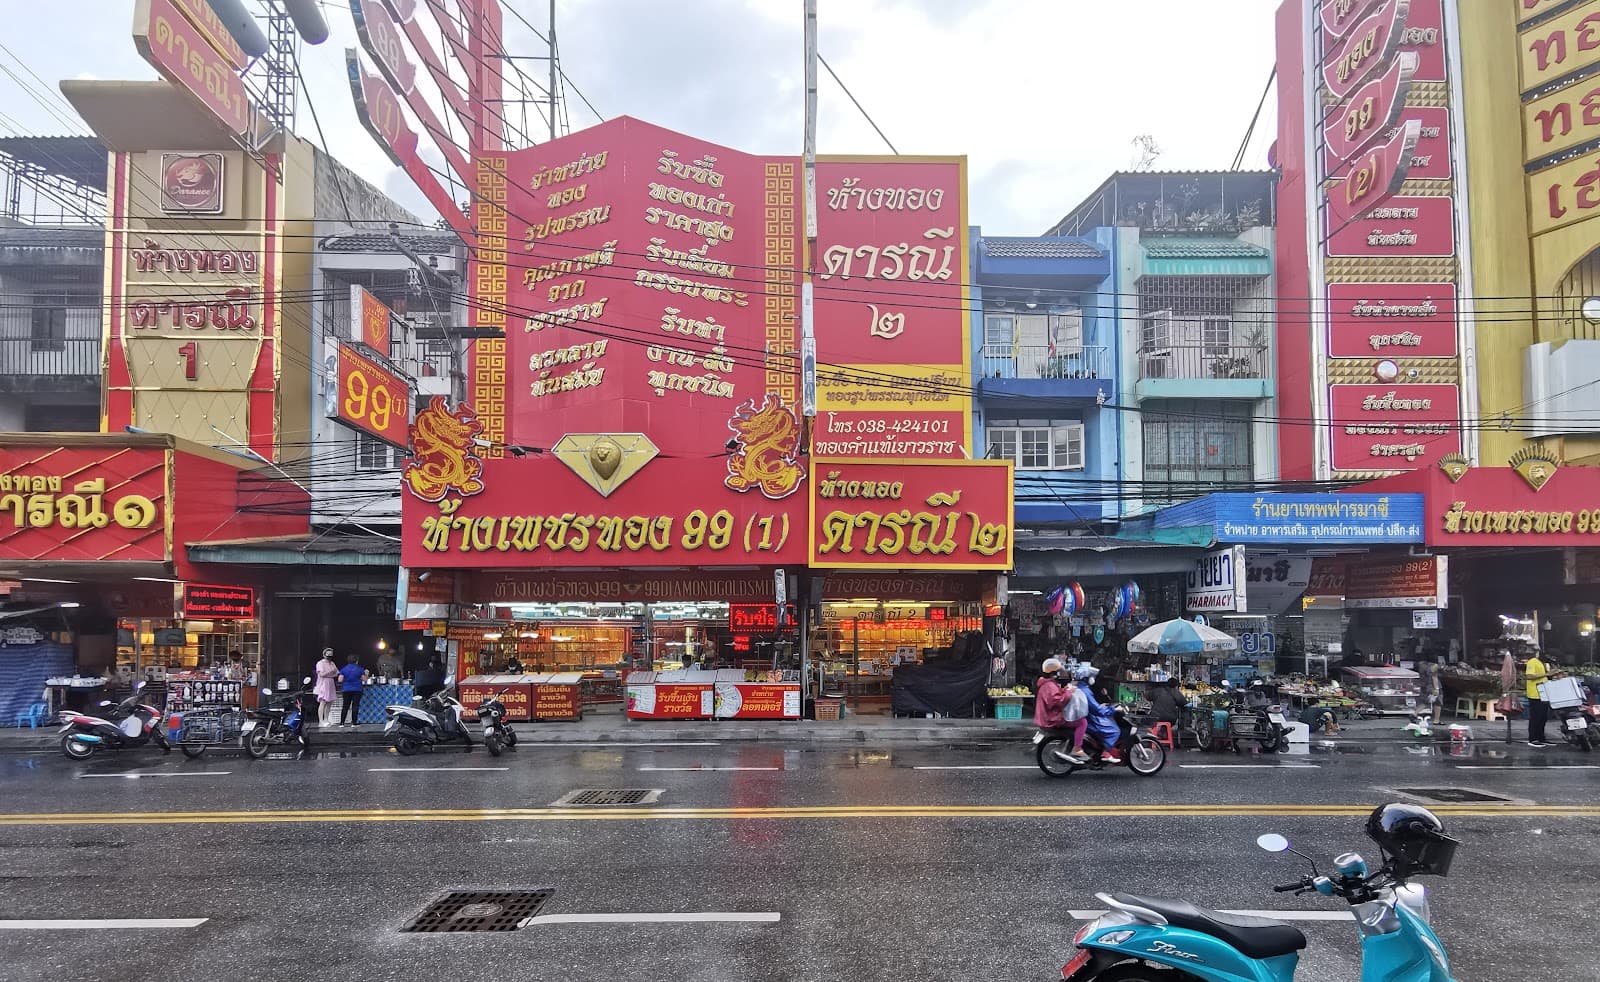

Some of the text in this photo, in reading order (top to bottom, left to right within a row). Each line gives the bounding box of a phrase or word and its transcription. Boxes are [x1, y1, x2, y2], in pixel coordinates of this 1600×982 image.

[1345, 97, 1373, 142] 99
[656, 149, 725, 188] รับซื้อ
[1346, 154, 1377, 205] (2)
[547, 184, 587, 209] ทอง
[648, 182, 736, 218] ทองเก่า
[826, 177, 945, 211] ห้างทอง
[524, 205, 611, 252] รูปพรรณ
[644, 207, 735, 246] ราคาสูง
[131, 238, 258, 274] ห้างทอง
[820, 226, 956, 281] ดารณี
[547, 280, 586, 303] จาก
[634, 270, 749, 306] กรอบพระ
[130, 285, 256, 331] ดารณี
[661, 306, 726, 342] รับทำ
[867, 303, 906, 340] ๒
[178, 341, 198, 381] 1
[529, 339, 608, 371] ลวดลาย
[530, 361, 605, 396] ทันสมัย
[648, 370, 736, 399] ทุกชนิด
[344, 370, 391, 431] 99
[815, 434, 957, 455] ทองคำแท้เยาวราช
[819, 471, 904, 499] ห้างทอง
[113, 494, 156, 528] ๑
[420, 498, 790, 553] ห้างเพชรทอง 99 (1)
[818, 490, 1007, 555] ดารณี ๒
[1444, 501, 1574, 534] ห้างเพชรทอง
[1187, 594, 1233, 609] PHARMACY
[1242, 632, 1275, 654] ยา
